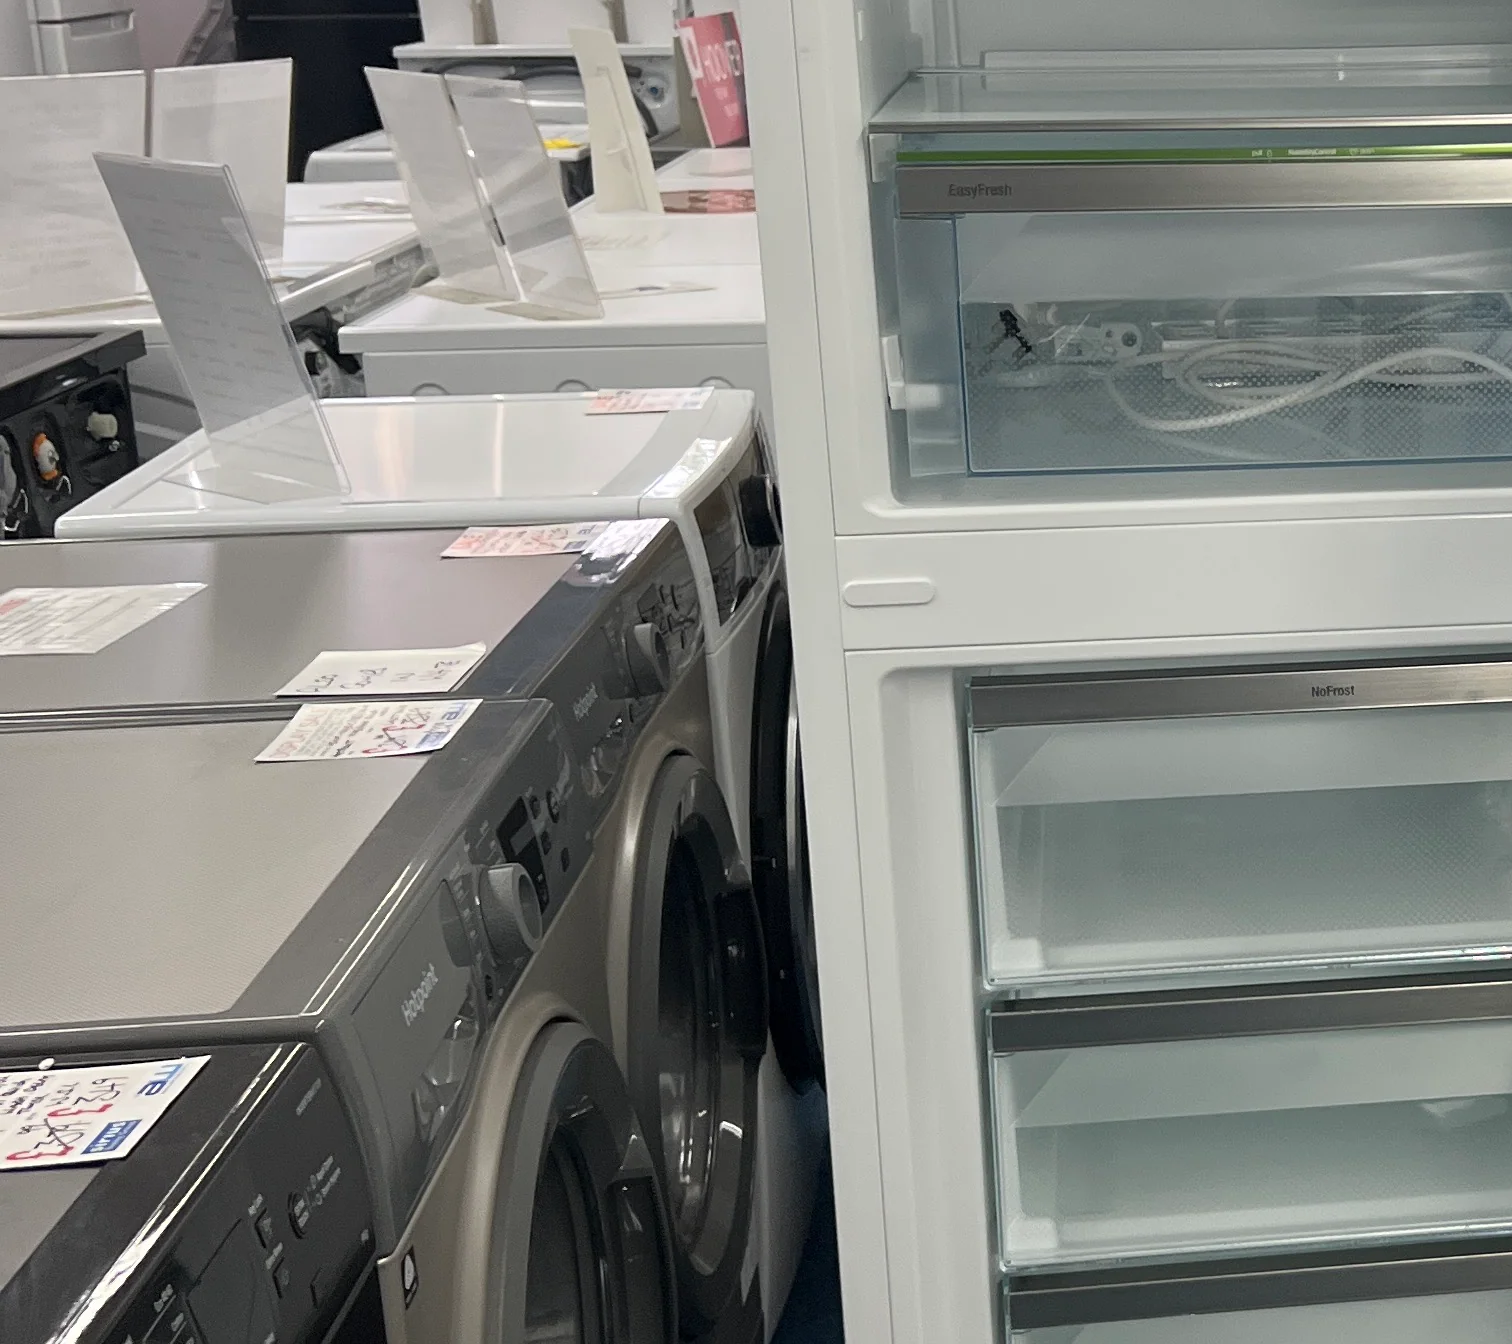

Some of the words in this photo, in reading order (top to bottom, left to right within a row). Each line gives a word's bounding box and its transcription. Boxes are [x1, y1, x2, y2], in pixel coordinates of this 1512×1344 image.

[948, 183, 1013, 199] EasyFresh
[1310, 685, 1355, 698] NoFrost
[401, 962, 439, 1027] Hotpoint
[89, 1121, 127, 1153] sirius
